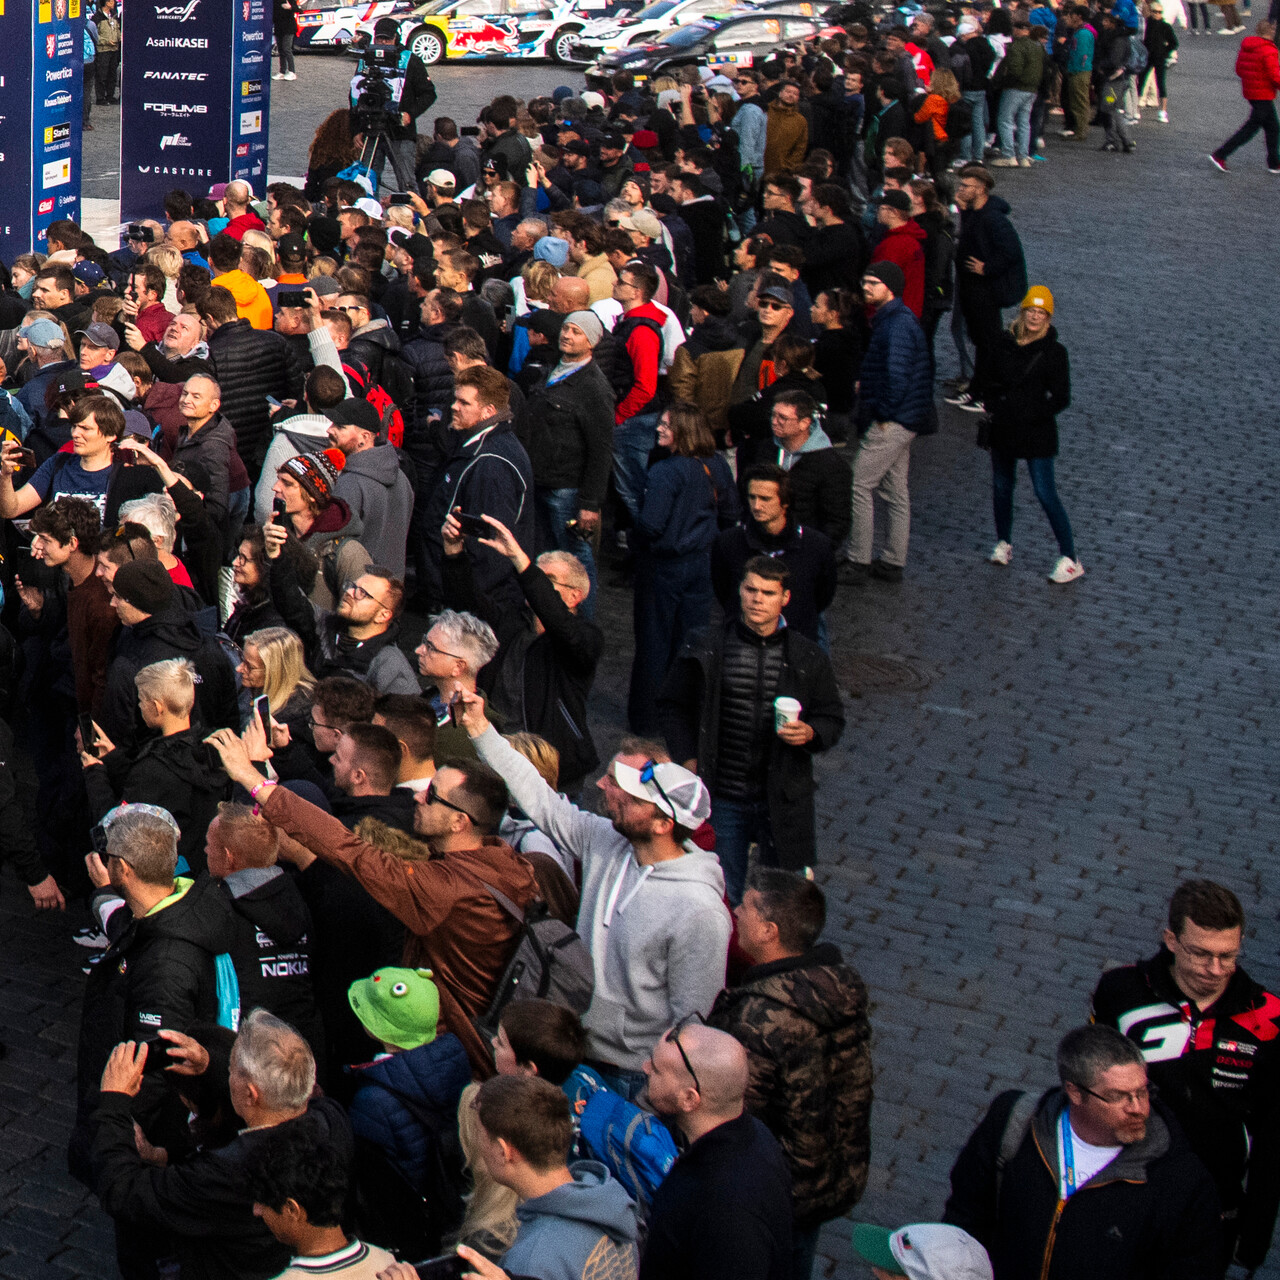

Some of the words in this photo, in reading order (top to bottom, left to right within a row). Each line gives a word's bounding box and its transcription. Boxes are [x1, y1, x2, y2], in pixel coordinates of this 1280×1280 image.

[242, 31, 264, 41] Powertica
[46, 67, 73, 82] Powertica
[144, 72, 206, 81] FANATEC
[144, 103, 207, 113] FORUM8
[53, 125, 69, 138] Starline
[154, 167, 212, 177] CASTORE
[261, 962, 308, 977] NOKIA
[1216, 1056, 1253, 1067] DENSO
